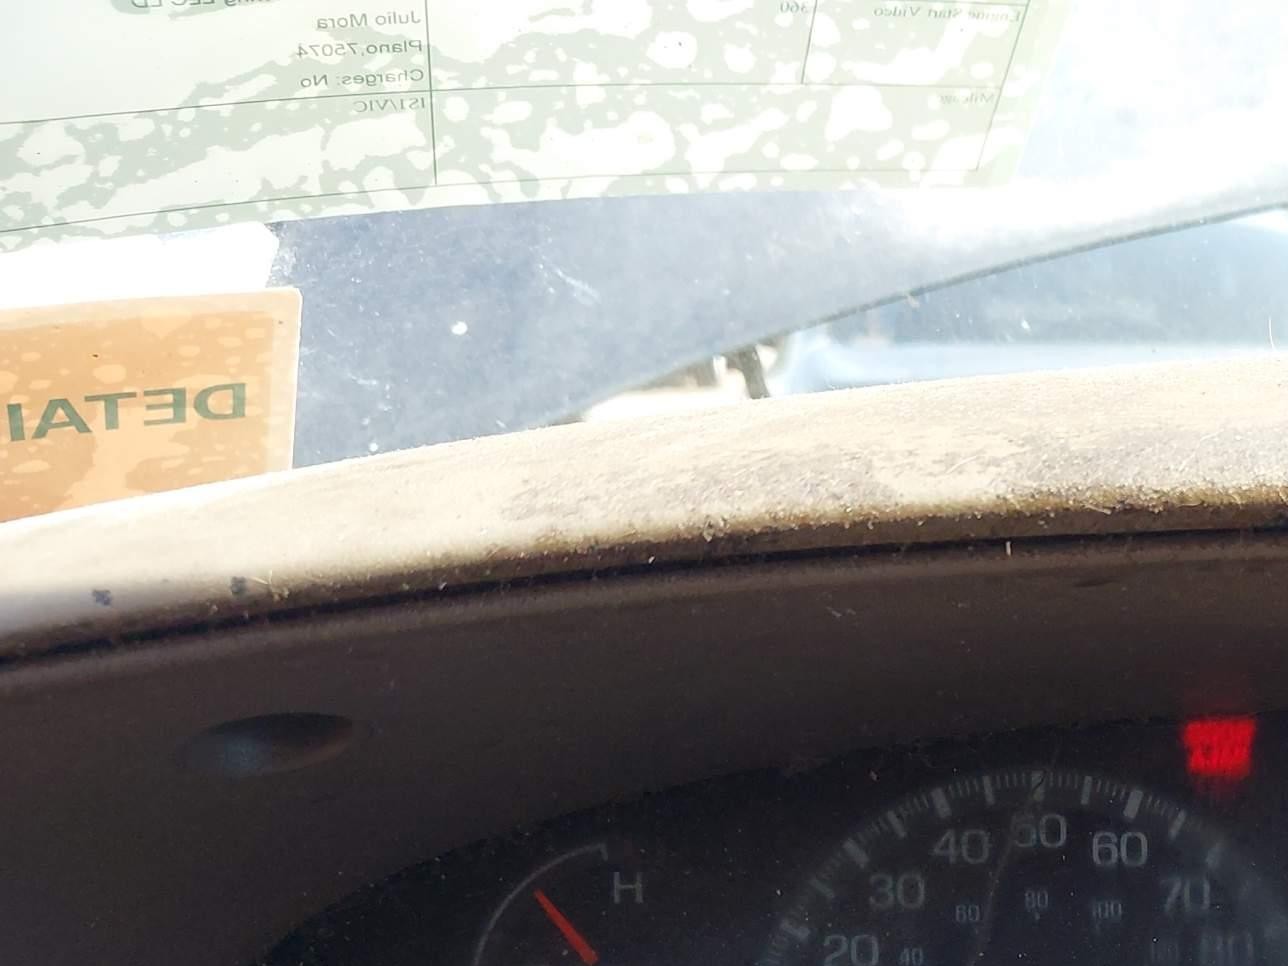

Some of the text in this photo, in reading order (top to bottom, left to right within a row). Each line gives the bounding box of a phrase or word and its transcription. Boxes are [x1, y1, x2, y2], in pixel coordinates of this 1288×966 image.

[928, 828, 993, 866] 40
[1013, 812, 1068, 849] 50
[1090, 830, 1149, 868] 60
[612, 871, 645, 904] H
[868, 871, 926, 911] 30
[1160, 875, 1211, 914] 70
